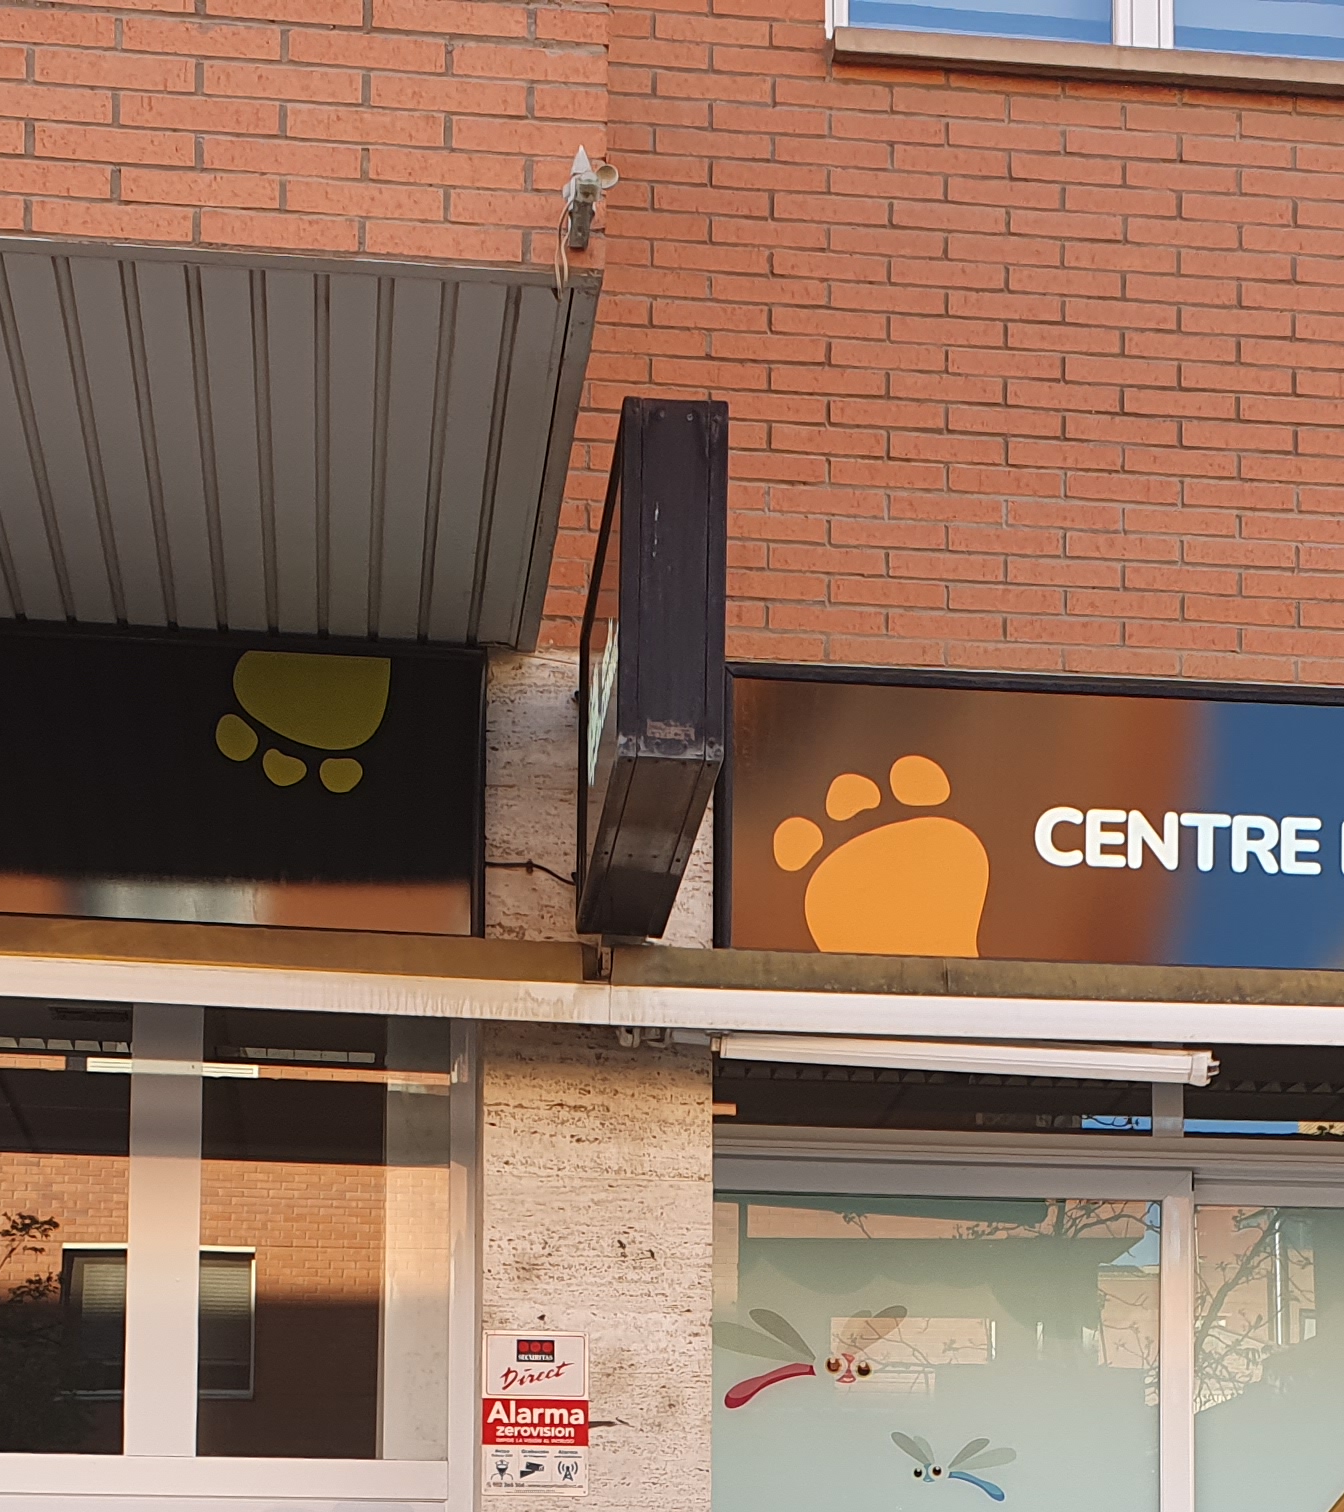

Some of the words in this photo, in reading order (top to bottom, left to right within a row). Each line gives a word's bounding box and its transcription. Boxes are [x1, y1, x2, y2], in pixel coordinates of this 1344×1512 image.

[1034, 806, 1322, 875] CENTRE
[500, 1361, 575, 1390] Direct
[487, 1401, 585, 1424] Alarma
[496, 1426, 574, 1437] zerovision
